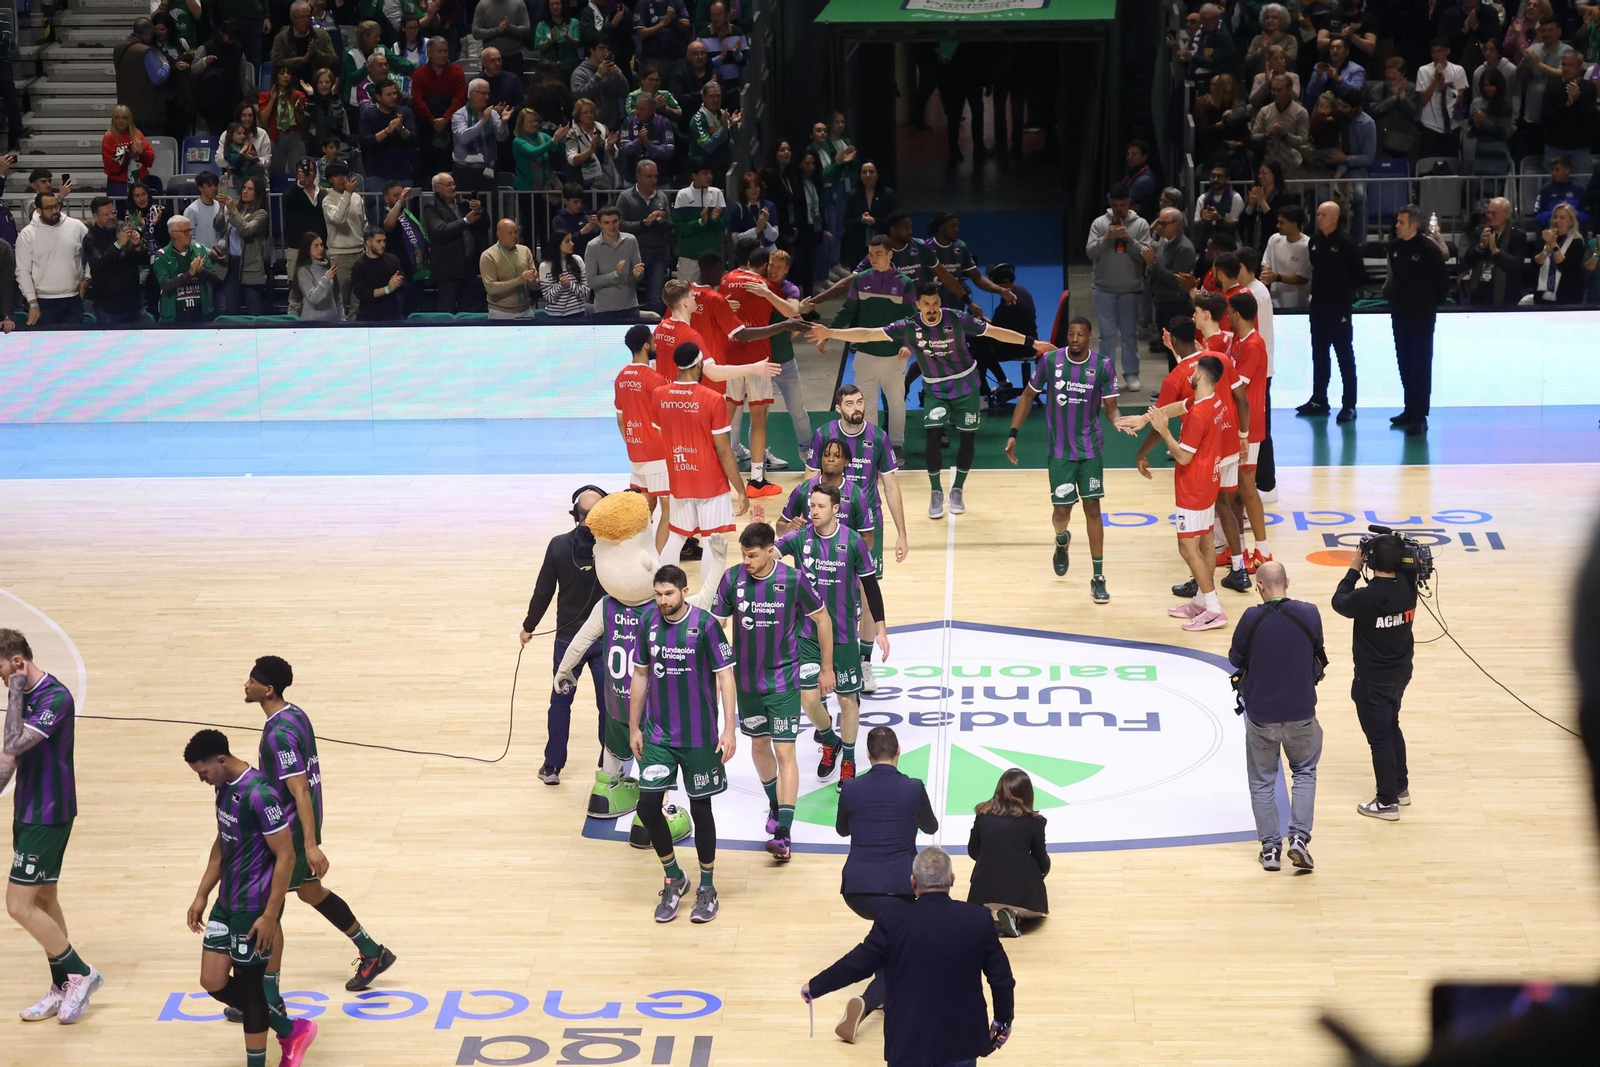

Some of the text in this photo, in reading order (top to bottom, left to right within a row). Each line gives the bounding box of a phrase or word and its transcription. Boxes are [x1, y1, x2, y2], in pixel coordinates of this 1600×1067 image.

[1066, 381, 1094, 390] Fundación
[1066, 386, 1087, 394] Unicaja
[815, 558, 846, 567] Fundación
[815, 564, 837, 573] Unicaja
[751, 606, 776, 615] Unicaja
[661, 645, 696, 655] Fundación
[661, 651, 686, 662] Unicaja
[870, 665, 1158, 681] Balonce
[861, 686, 1093, 704] Unica
